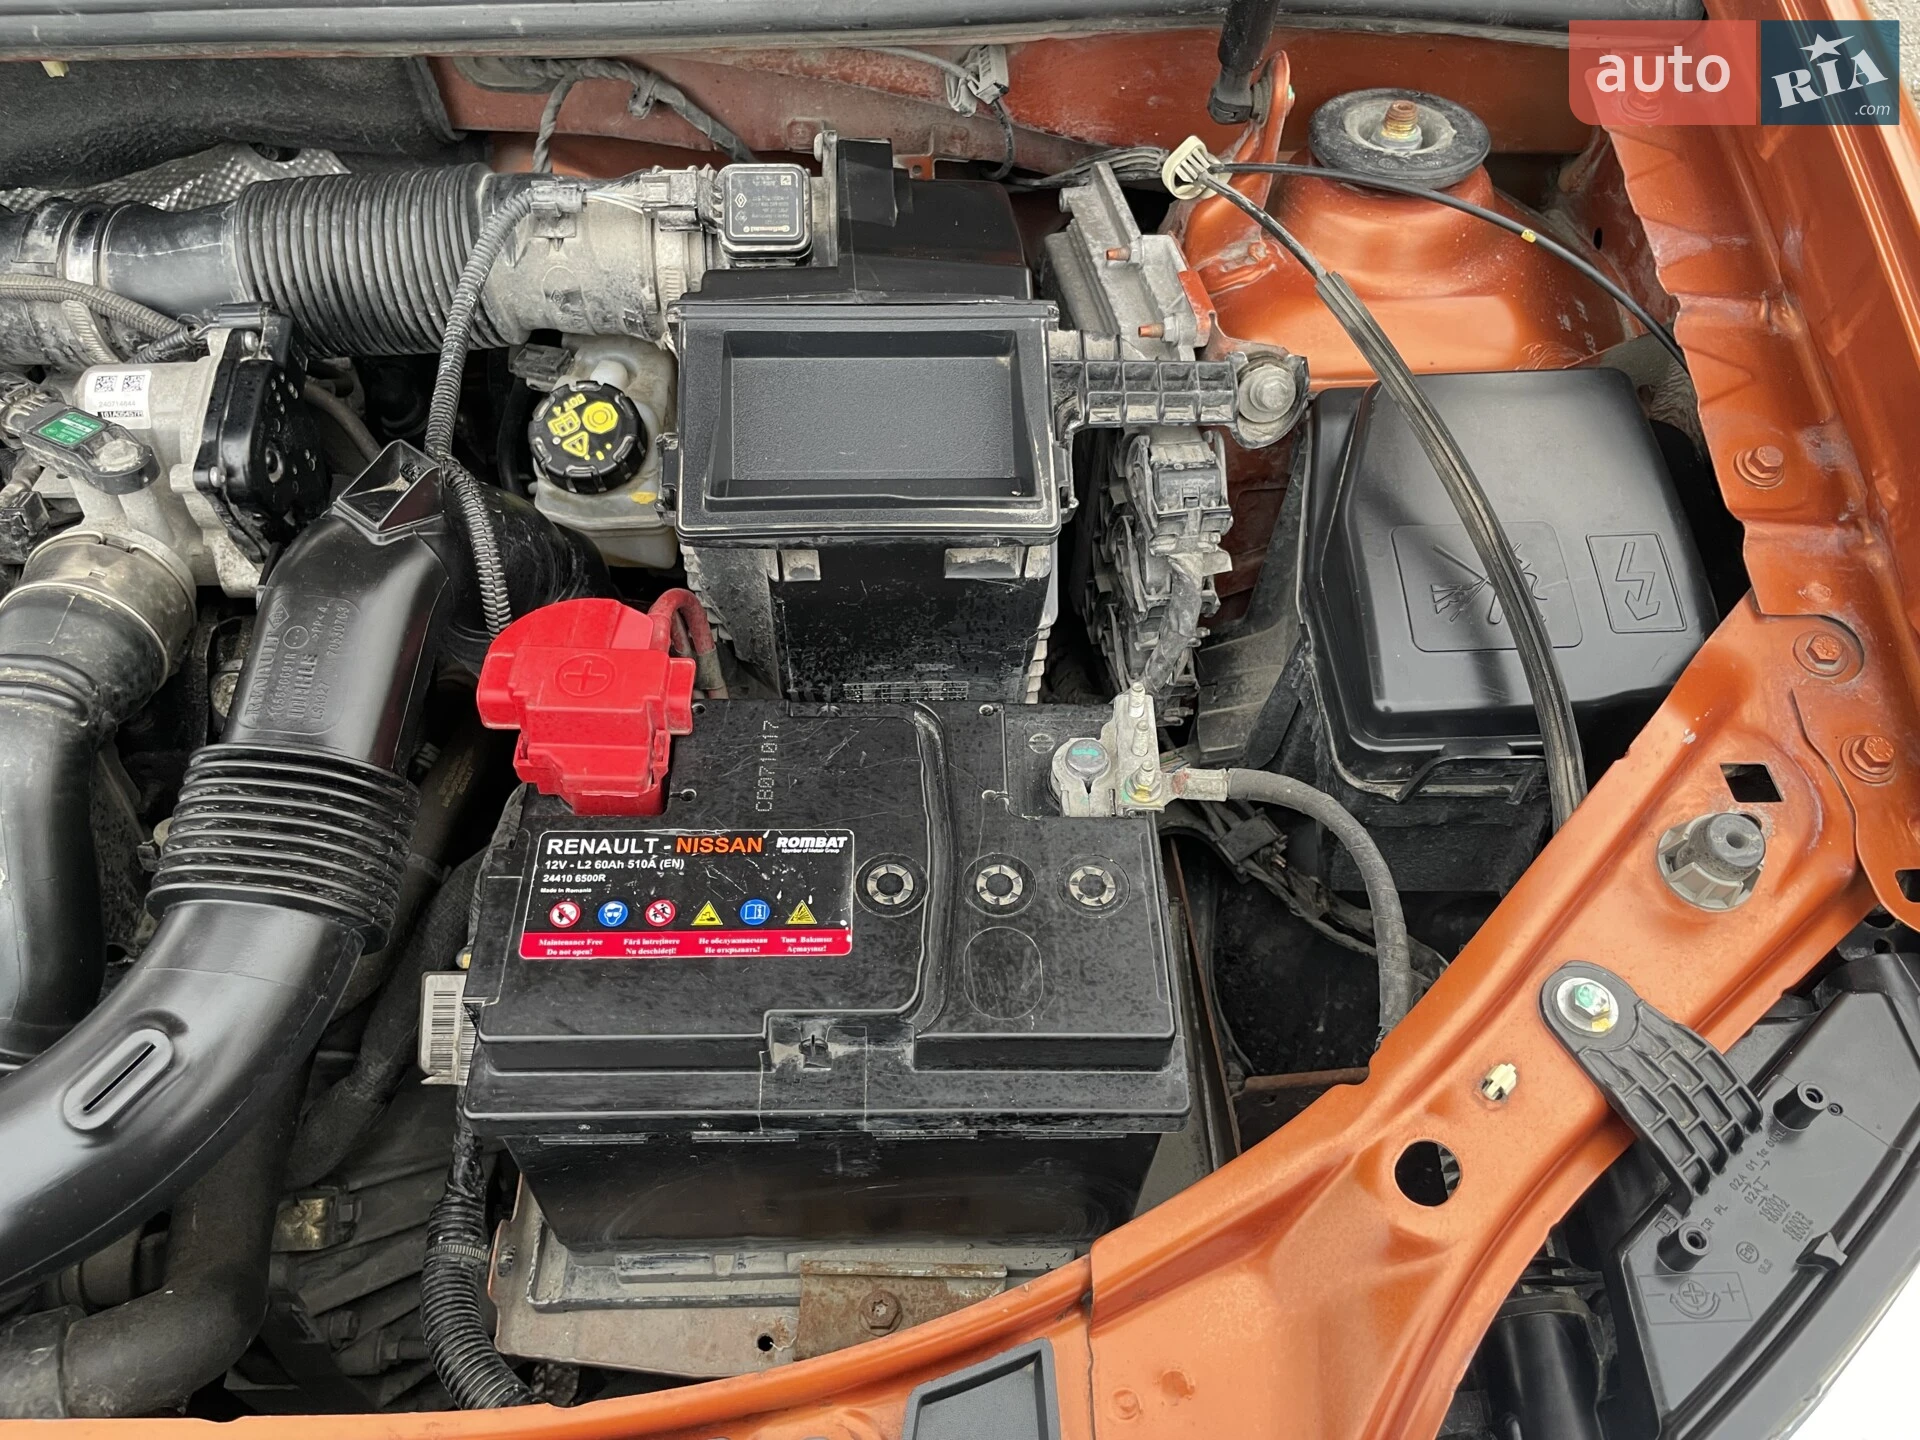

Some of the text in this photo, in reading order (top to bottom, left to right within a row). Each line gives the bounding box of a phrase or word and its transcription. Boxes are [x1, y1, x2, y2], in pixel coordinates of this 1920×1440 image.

[552, 393, 586, 416] DOT 4
[755, 720, 779, 812] CB071017
[546, 837, 660, 855] RENAULT
[676, 836, 763, 854] NISSAN
[776, 836, 848, 848] ROMBAT
[545, 860, 568, 869] 12V
[577, 860, 592, 869] L2
[594, 859, 625, 869] 60Ah
[627, 859, 657, 869] 510A
[659, 858, 685, 870] (EN)
[542, 873, 606, 883] 24410 6500R
[538, 938, 603, 946] Maintenance Free
[546, 948, 557, 956] Do
[572, 948, 593, 957] open!
[1713, 1203, 1729, 1216] PL
[1729, 1173, 1747, 1191] 02A
[1745, 1159, 1759, 1171] 01
[1744, 1187, 1762, 1204] 02A
